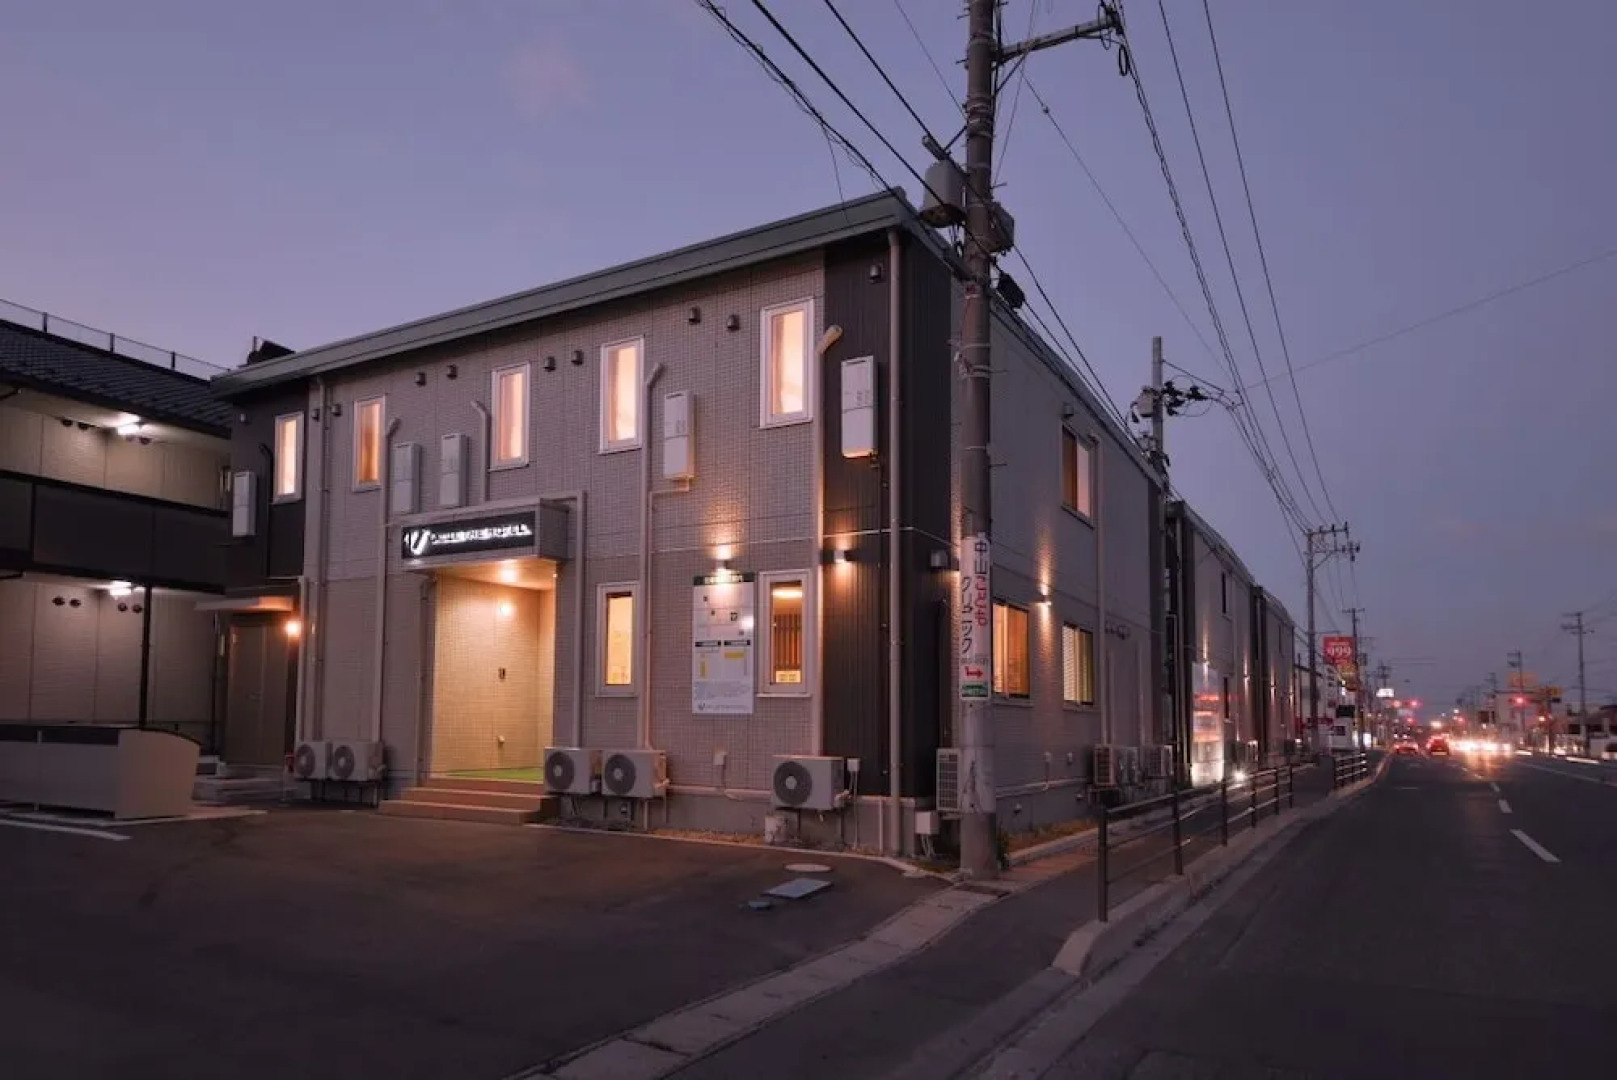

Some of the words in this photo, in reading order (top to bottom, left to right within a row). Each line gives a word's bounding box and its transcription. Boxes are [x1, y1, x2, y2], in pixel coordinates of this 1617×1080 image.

[962, 576, 973, 654] クリニック
